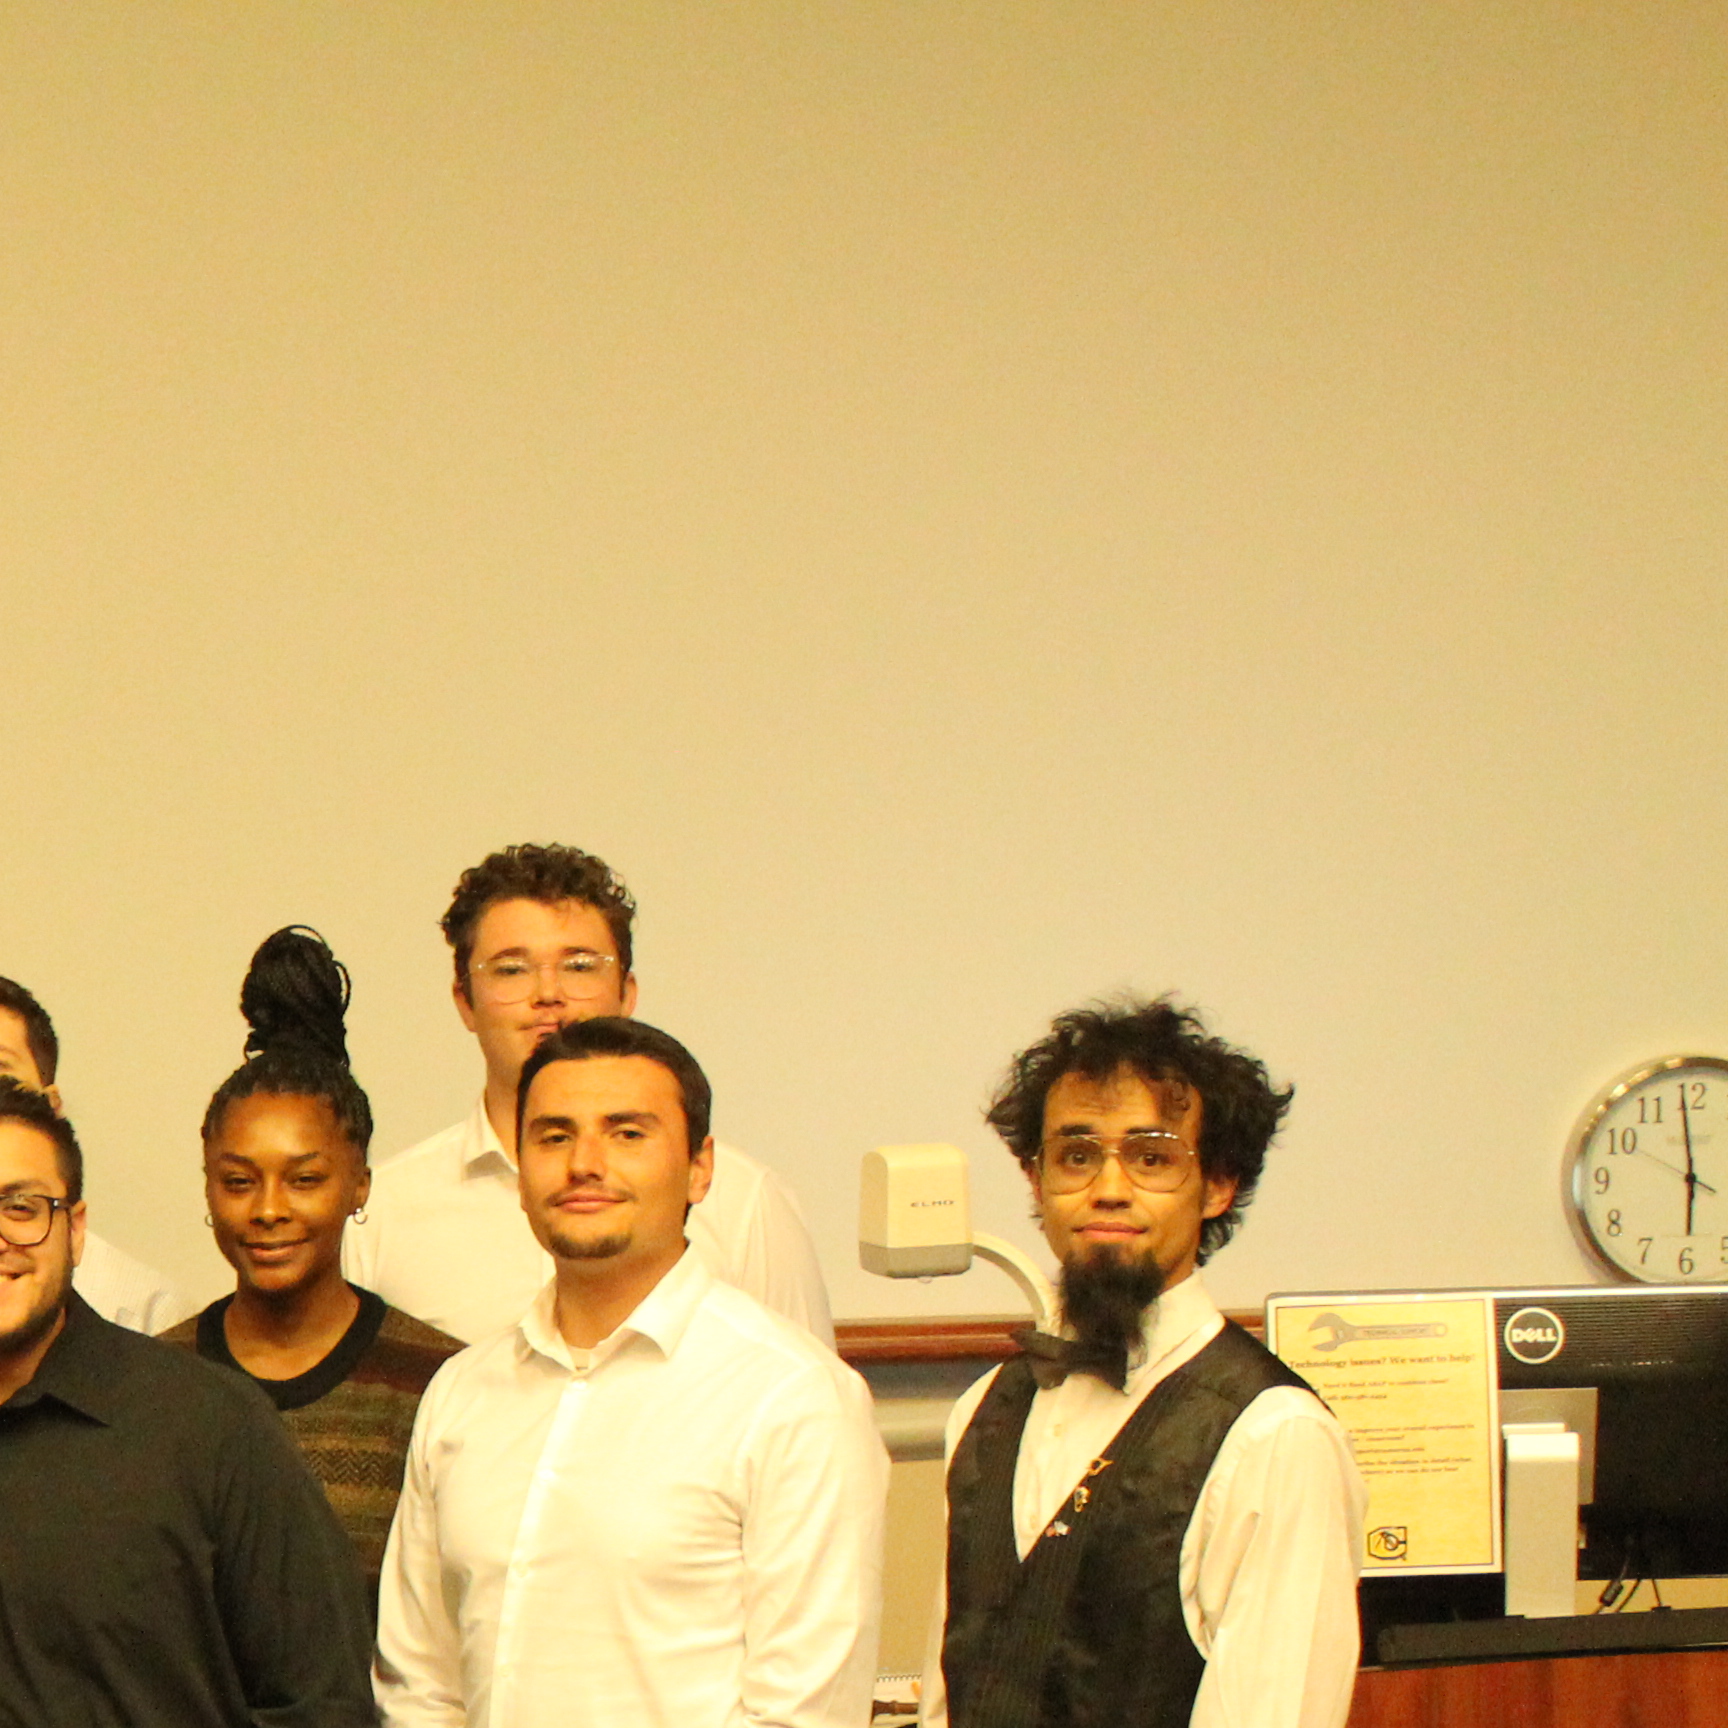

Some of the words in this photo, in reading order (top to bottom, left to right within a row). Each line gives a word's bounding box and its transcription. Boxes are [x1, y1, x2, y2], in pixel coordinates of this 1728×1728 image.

[1637, 1096, 1663, 1124] 11
[1677, 1083, 1707, 1110] 12
[1606, 1127, 1637, 1155] 10
[1594, 1166, 1610, 1195] 9
[910, 1200, 954, 1208] ELMO
[1606, 1208, 1622, 1237] 8
[1637, 1237, 1653, 1265] 7
[1678, 1247, 1694, 1275] 6
[1511, 1327, 1557, 1343] DELL
